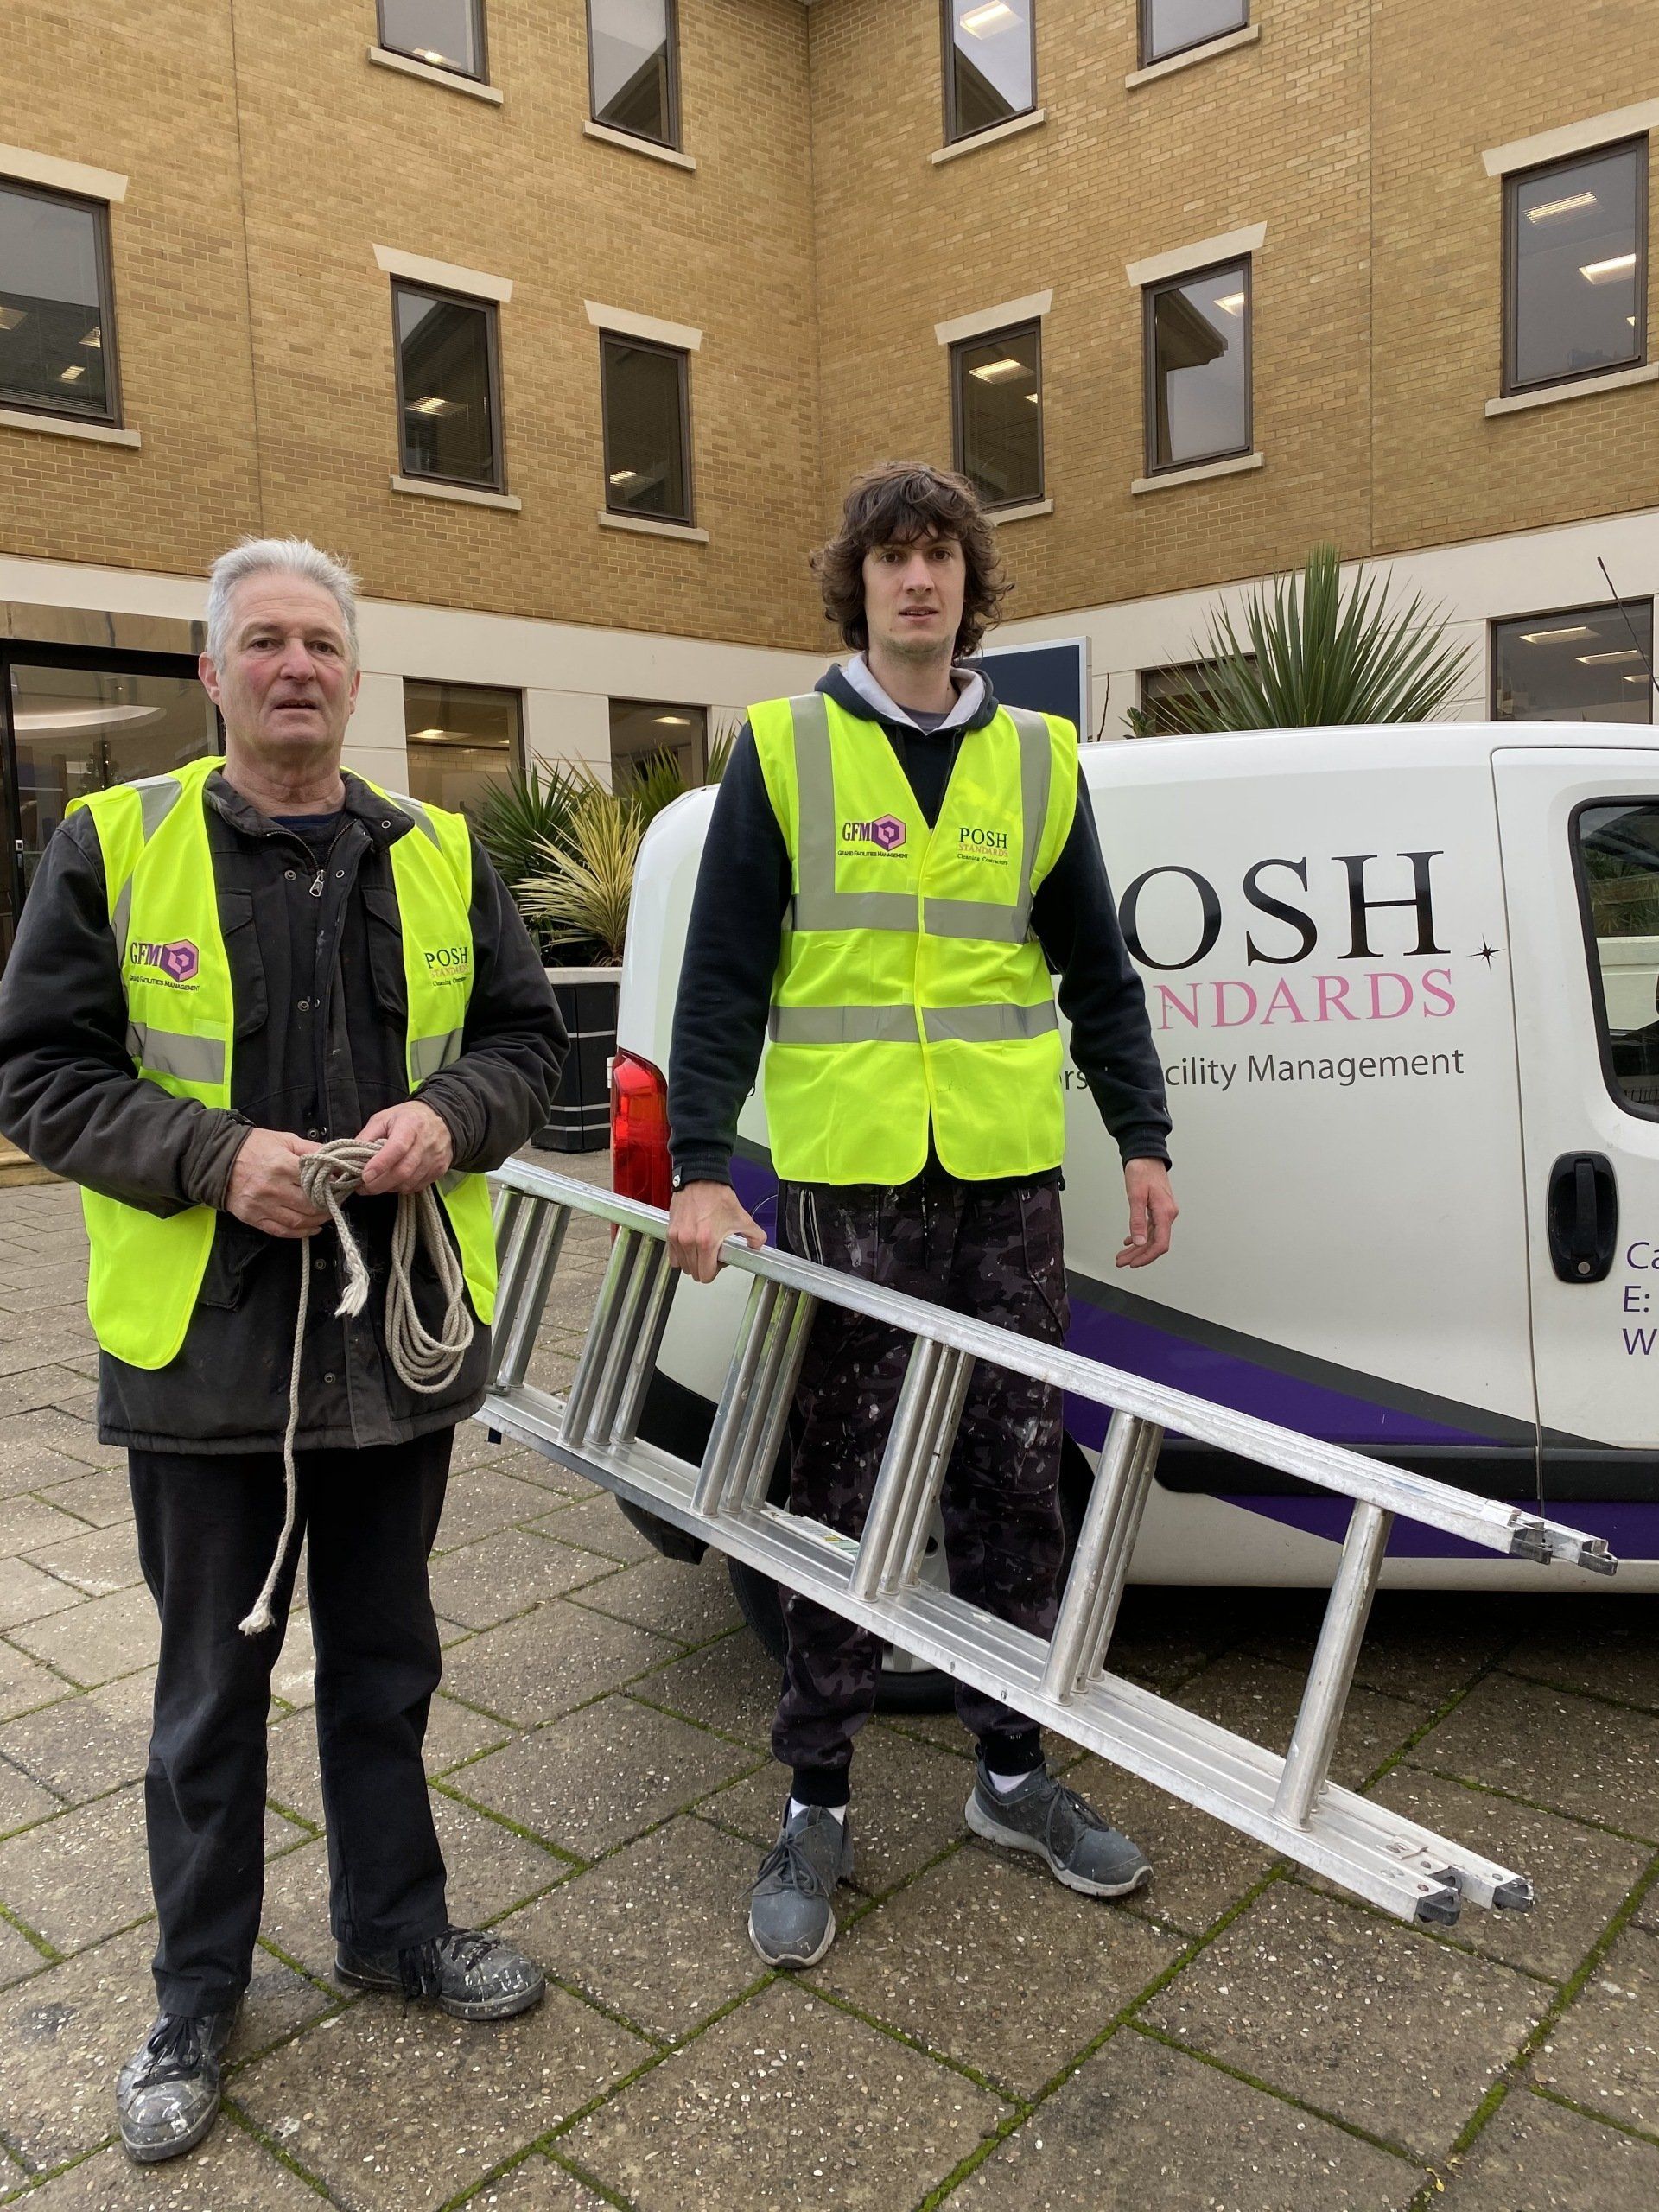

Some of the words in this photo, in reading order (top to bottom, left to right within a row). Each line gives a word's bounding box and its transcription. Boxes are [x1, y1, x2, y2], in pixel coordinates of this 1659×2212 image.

[842, 822, 871, 842] GFM
[959, 827, 1007, 849] POSH
[957, 853, 980, 862] Cleaning
[958, 843, 1008, 858] STANDARDS
[1118, 850, 1451, 970] OSH
[130, 942, 162, 967] GFM
[423, 946, 468, 969] POSH
[1153, 968, 1456, 1030] NDARDS
[1165, 1056, 1237, 1091] cility
[1248, 1049, 1465, 1087] Management
[1624, 1286, 1650, 1312] E:
